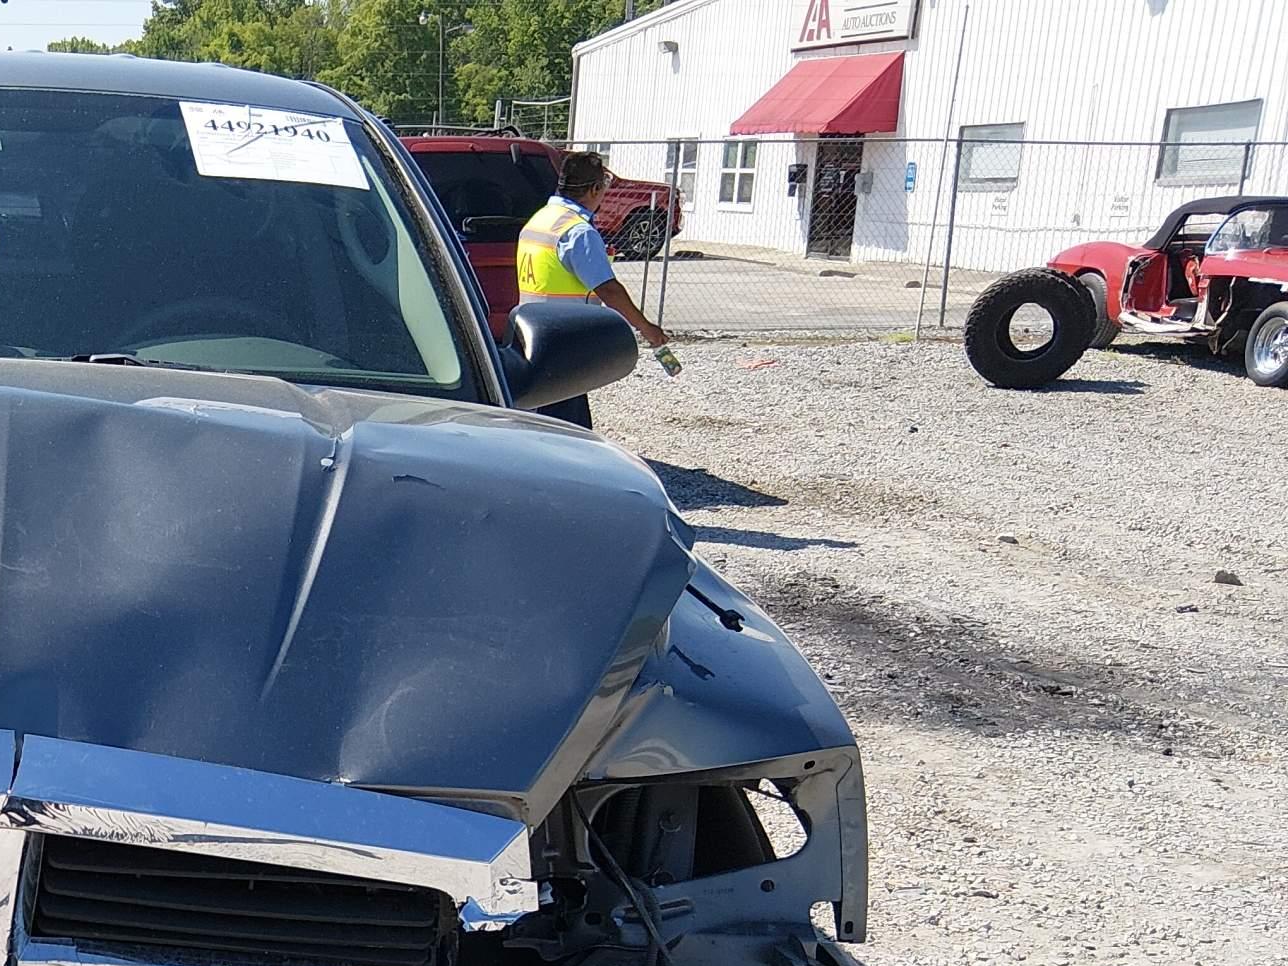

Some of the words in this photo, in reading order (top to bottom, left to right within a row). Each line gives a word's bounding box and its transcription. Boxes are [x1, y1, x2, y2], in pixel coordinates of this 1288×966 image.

[842, 15, 861, 30] AUTO
[861, 11, 896, 28] AUCTIONS
[204, 118, 331, 143] 44921940
